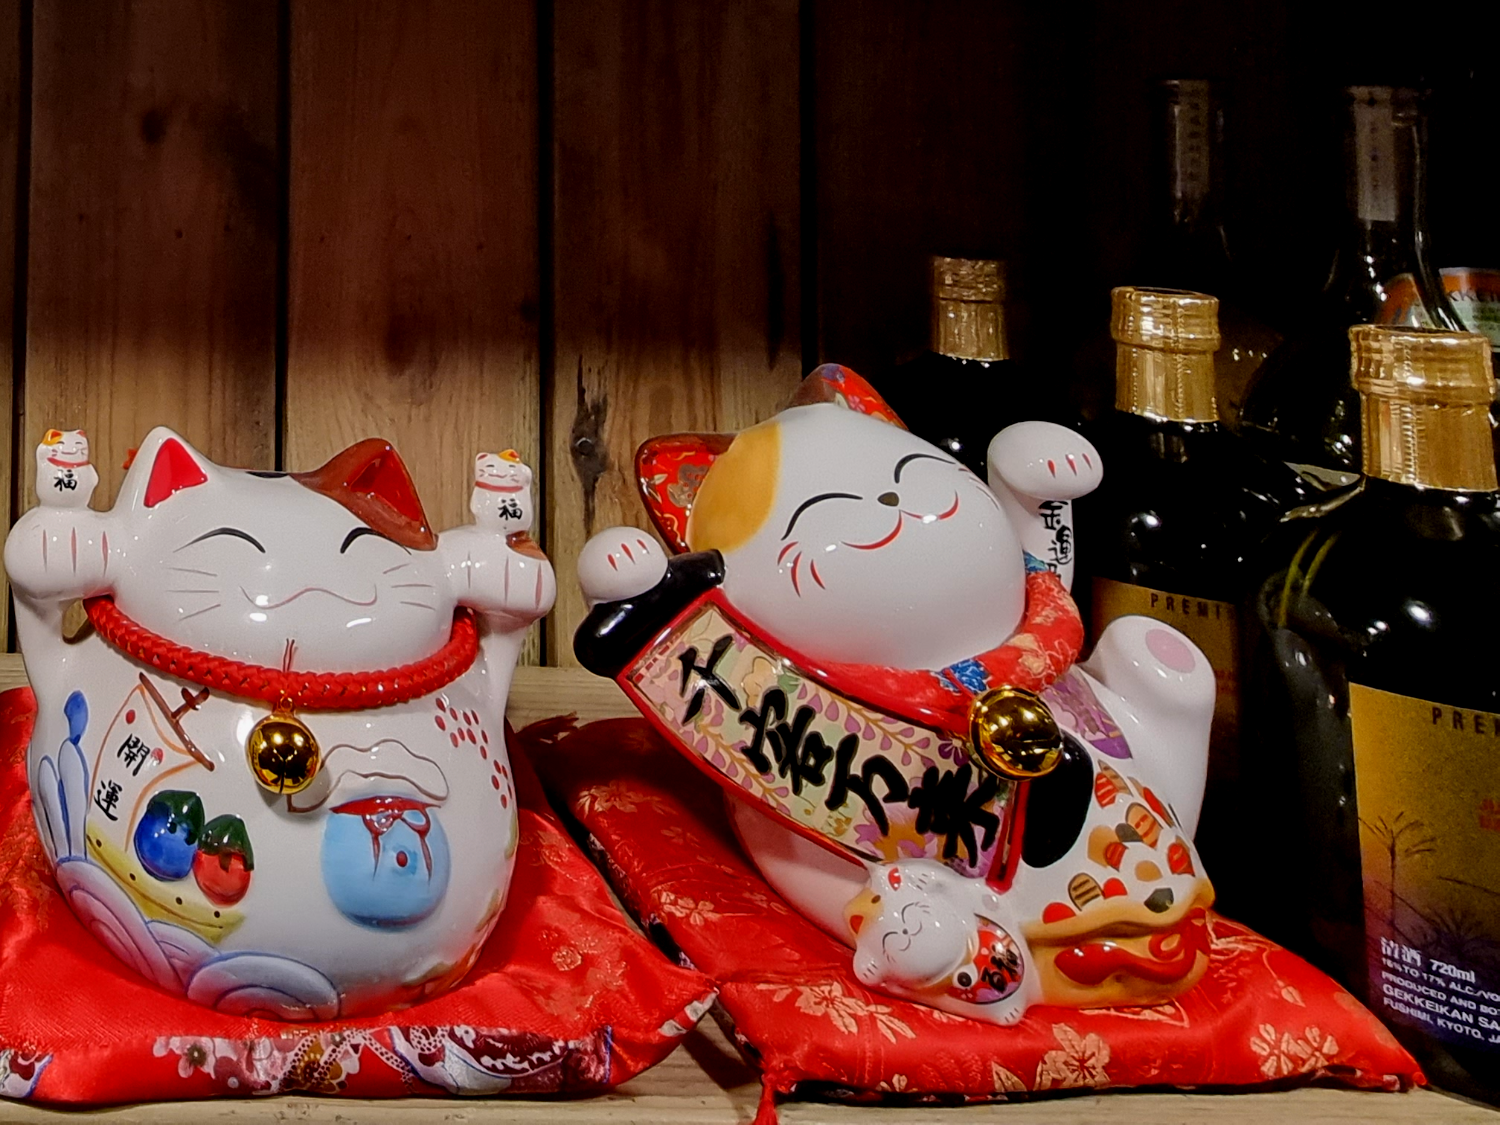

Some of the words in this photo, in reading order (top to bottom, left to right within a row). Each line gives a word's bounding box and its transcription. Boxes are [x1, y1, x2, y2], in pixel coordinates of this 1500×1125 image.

[53, 469, 78, 492] 福
[497, 498, 523, 521] 福
[1039, 500, 1072, 580] 金運
[93, 733, 151, 822] 開運
[1429, 959, 1476, 984] 720ml
[1381, 970, 1447, 1001] PRODUCED
[1450, 995, 1477, 1010] AND
[1480, 1004, 1500, 1016] BO
[1383, 983, 1474, 1024] GEKKEIKAN
